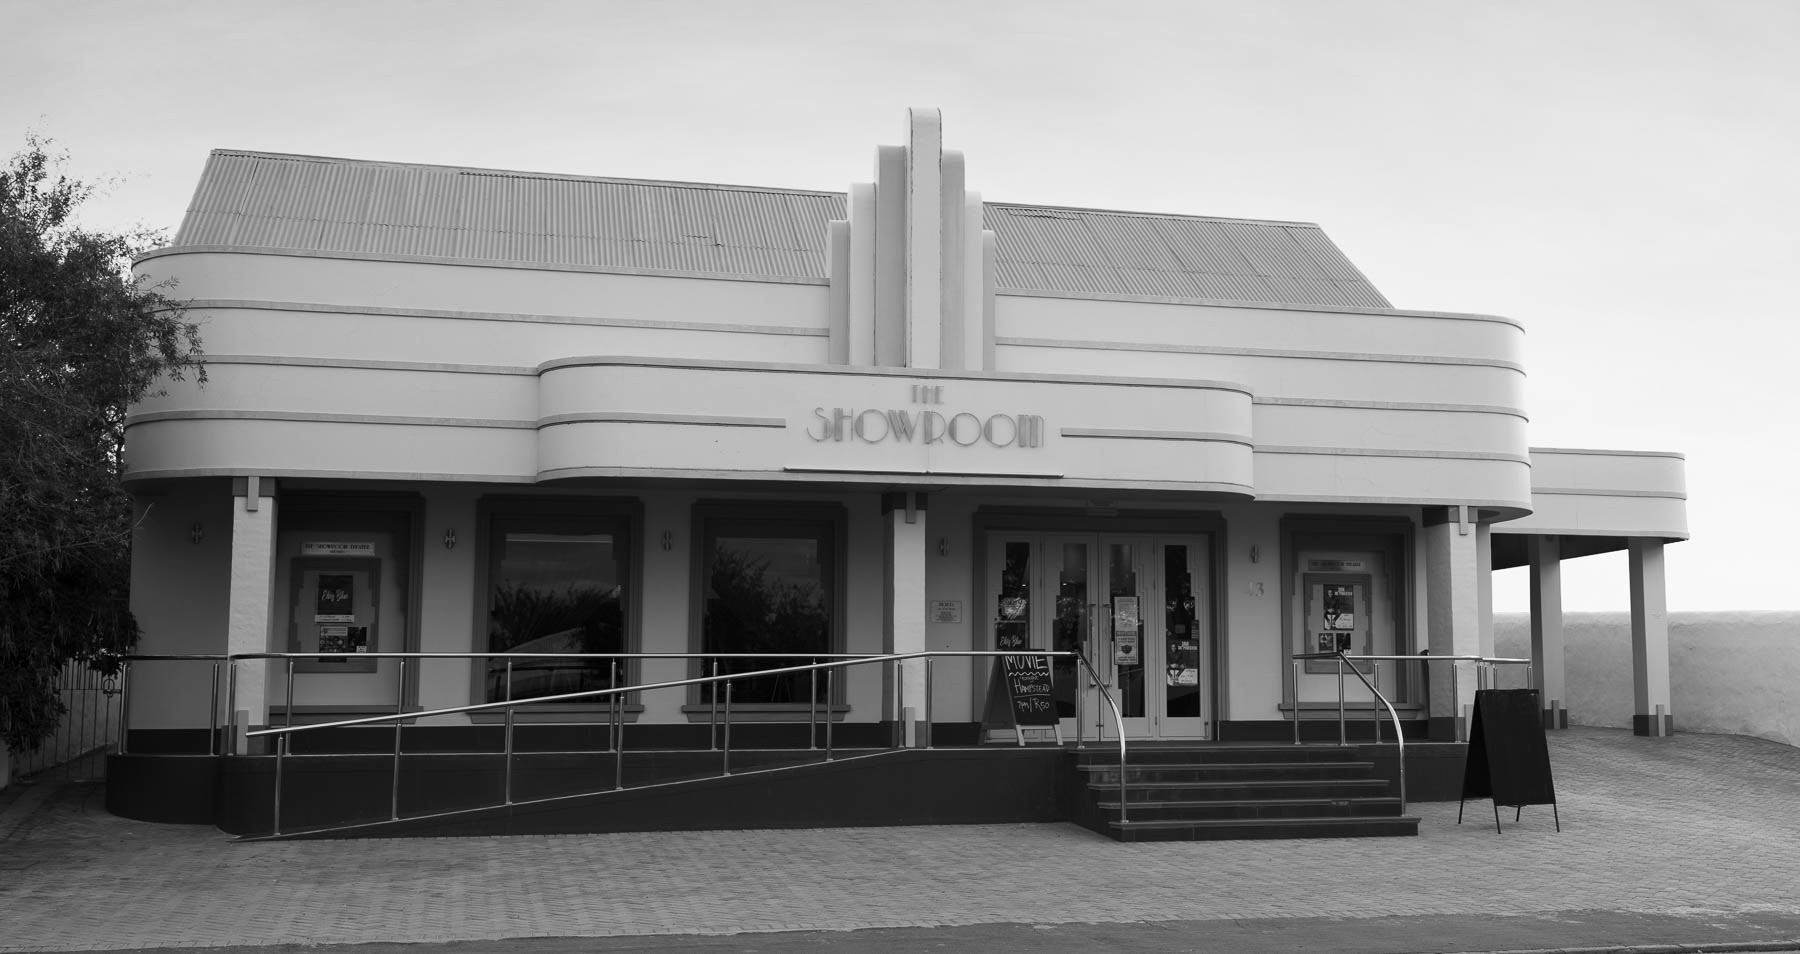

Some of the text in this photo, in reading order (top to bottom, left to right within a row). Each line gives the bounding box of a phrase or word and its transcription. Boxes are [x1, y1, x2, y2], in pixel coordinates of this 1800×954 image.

[911, 384, 944, 404] THE
[807, 407, 1044, 448] SHOWROOM
[1247, 581, 1264, 597] 13
[1005, 655, 1048, 670] MOVIE
[1013, 678, 1050, 694] HAMPSTEAD
